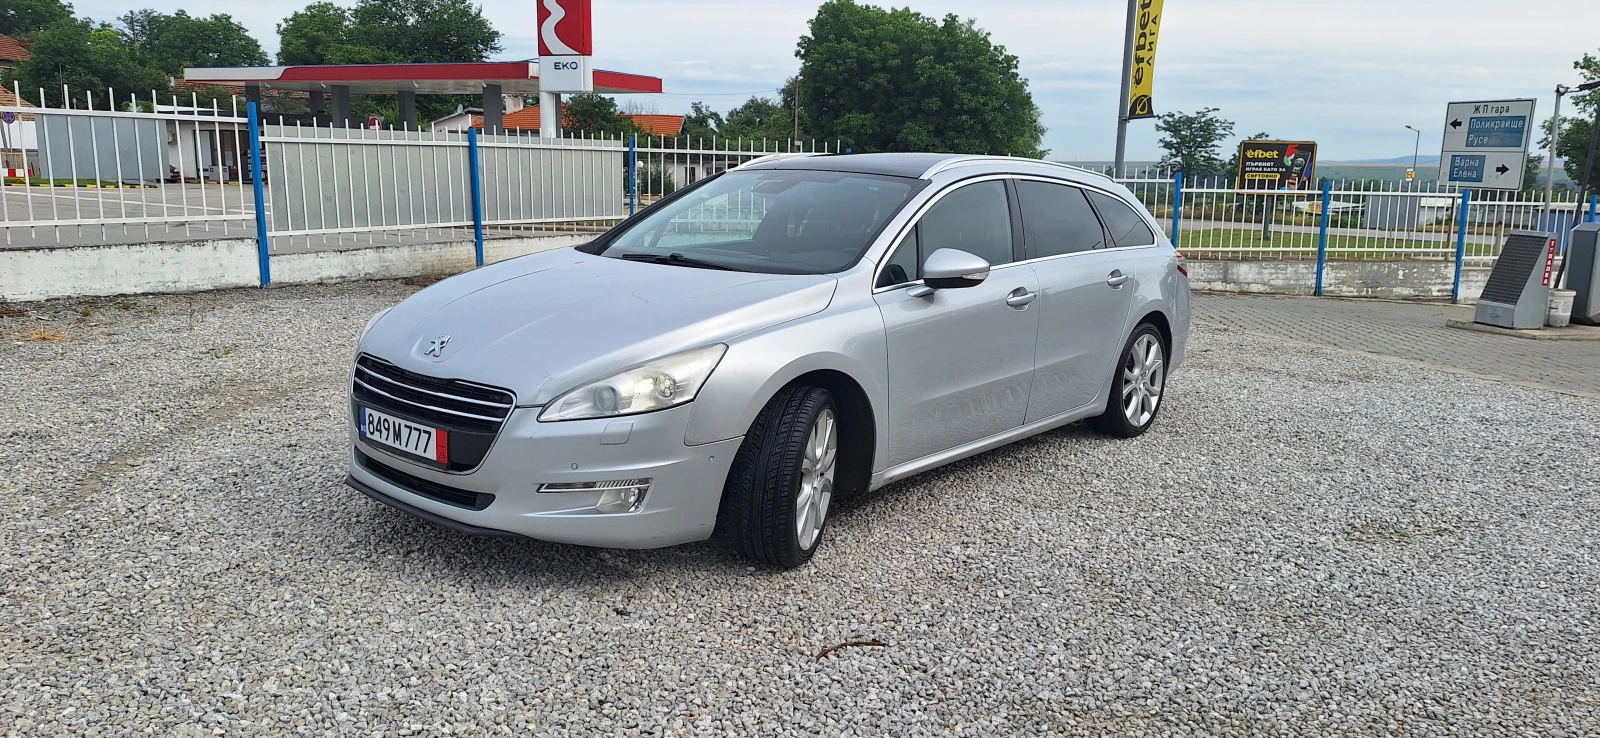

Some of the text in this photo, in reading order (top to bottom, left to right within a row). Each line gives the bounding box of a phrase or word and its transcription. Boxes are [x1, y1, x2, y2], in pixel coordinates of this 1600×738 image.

[554, 61, 578, 70] EKO
[1490, 105, 1510, 116] гара
[1470, 118, 1524, 130] Поликрайще
[1468, 134, 1488, 146] Русе
[1245, 148, 1279, 159] efbet
[1455, 157, 1479, 168] Варна
[1453, 168, 1477, 178] Елена
